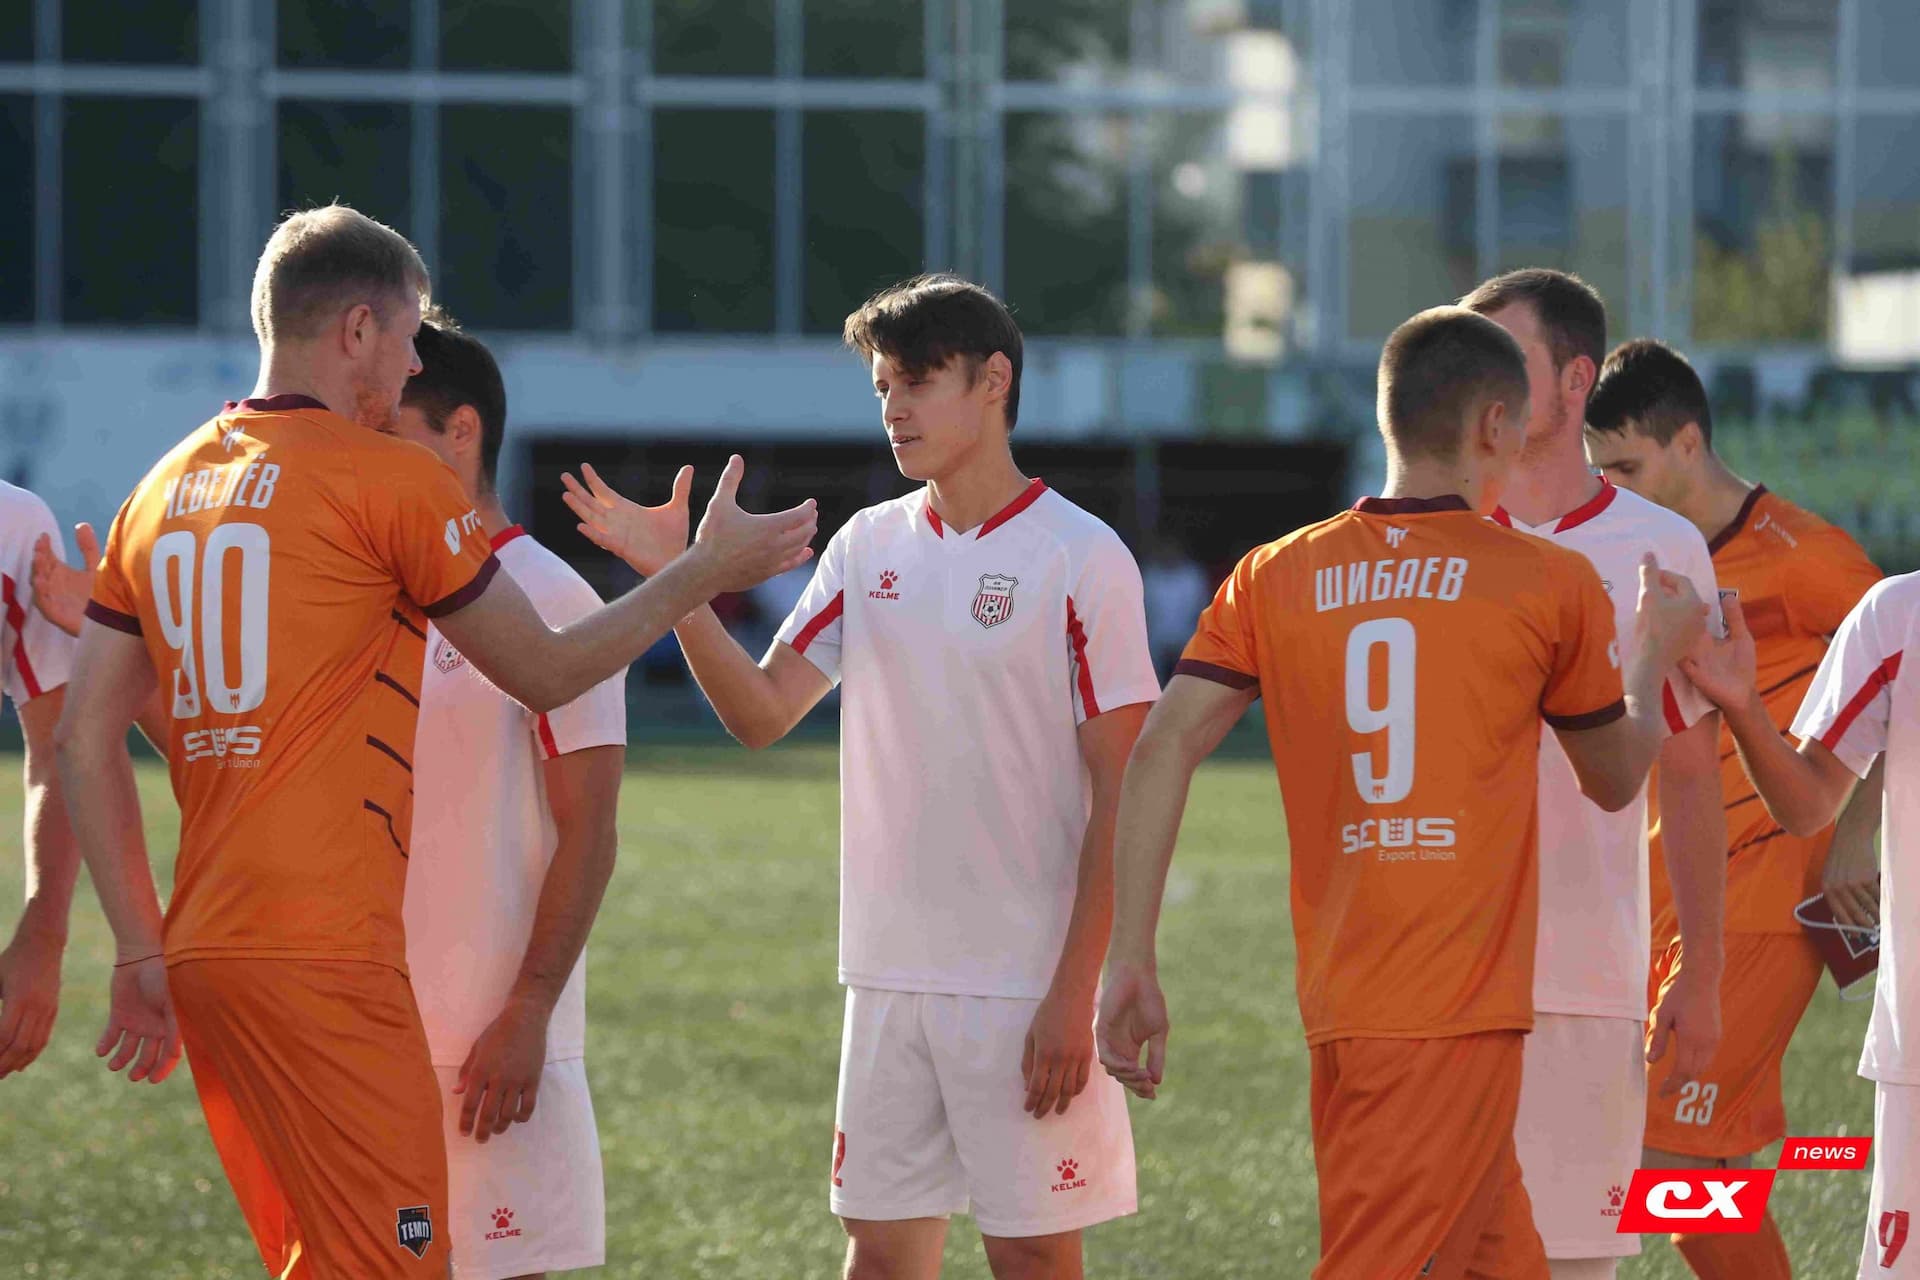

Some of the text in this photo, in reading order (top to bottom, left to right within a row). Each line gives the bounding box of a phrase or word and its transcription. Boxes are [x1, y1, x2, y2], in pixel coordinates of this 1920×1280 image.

[868, 590, 900, 601] KELME
[1315, 556, 1469, 613] ШИБАЕВ
[150, 522, 271, 720] 90
[1344, 617, 1417, 805] 9
[1342, 817, 1457, 855] SEUS
[1378, 849, 1457, 863] Export Union
[1674, 1080, 1719, 1126] 23
[1051, 1178, 1087, 1193] KELME
[484, 1228, 522, 1241] KELME
